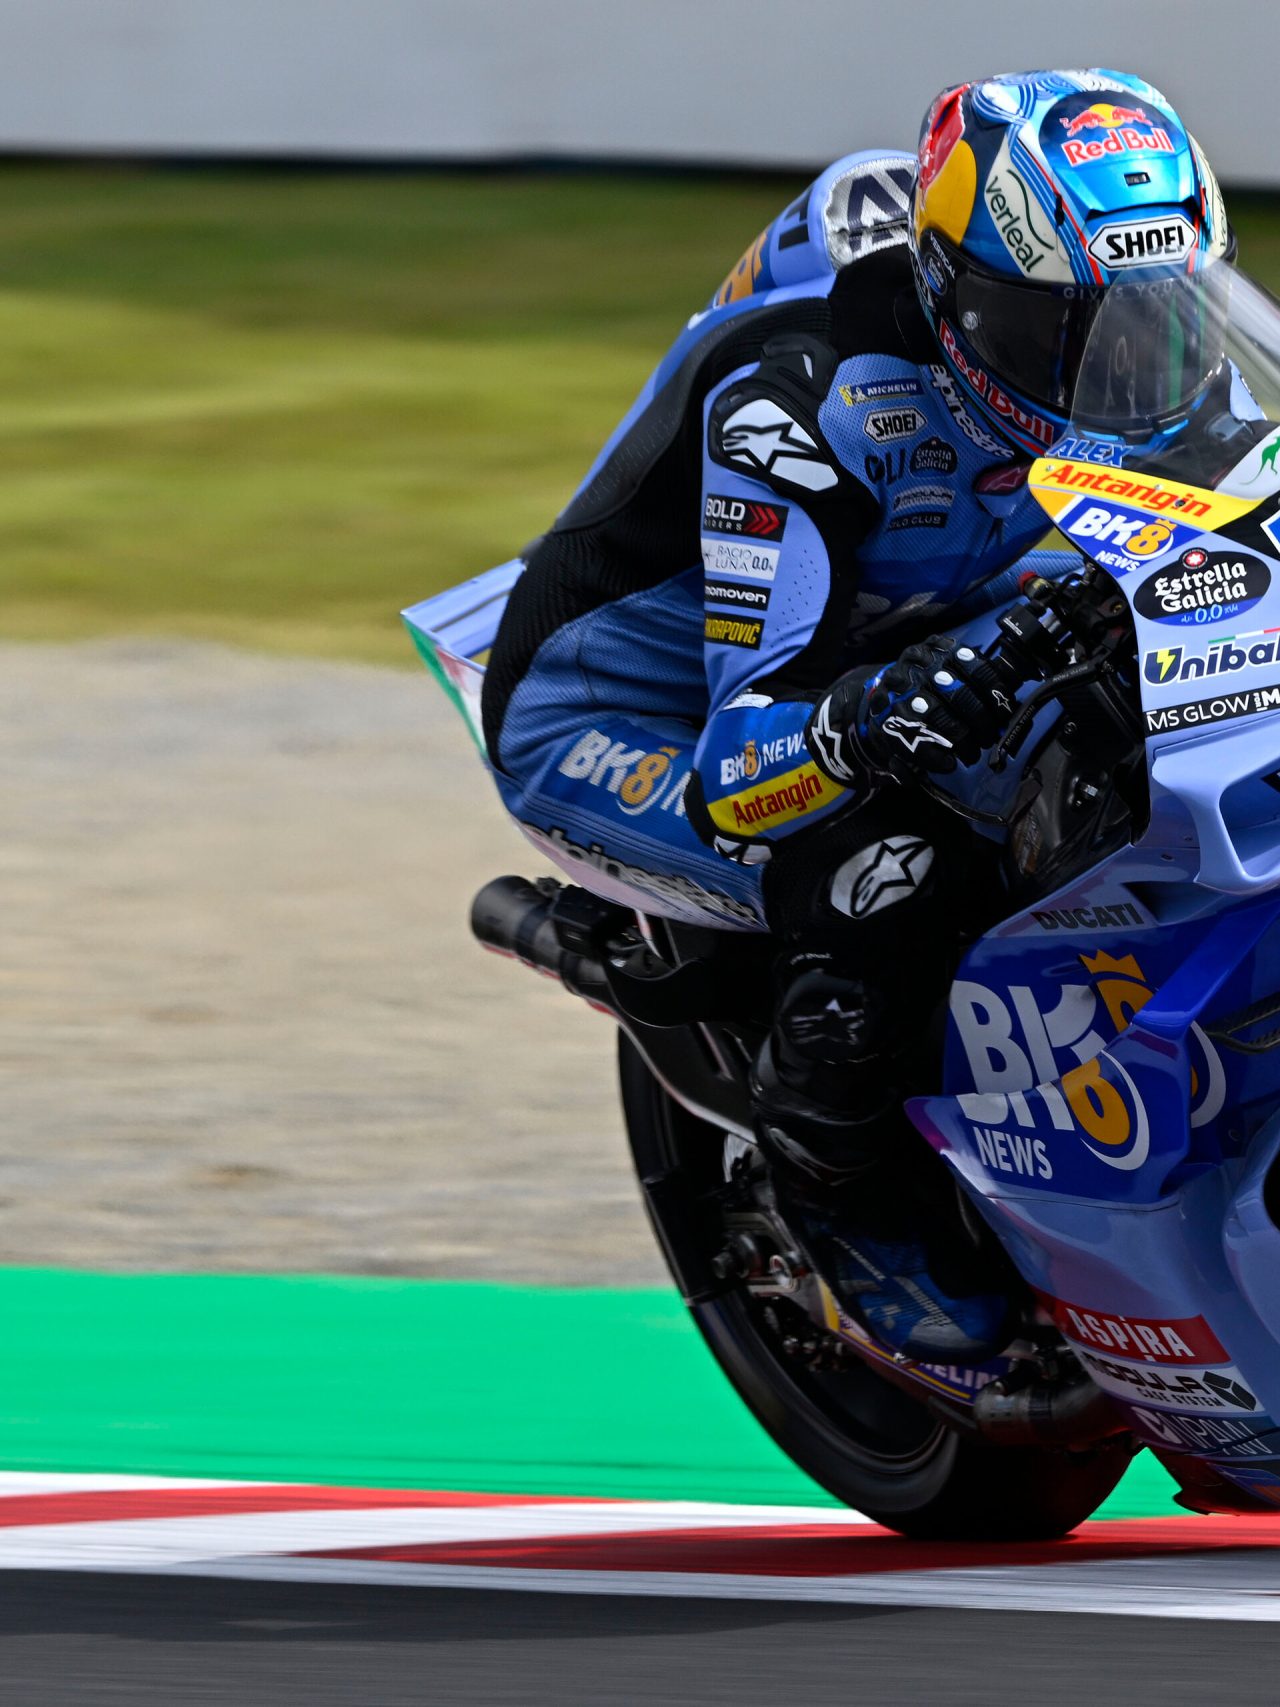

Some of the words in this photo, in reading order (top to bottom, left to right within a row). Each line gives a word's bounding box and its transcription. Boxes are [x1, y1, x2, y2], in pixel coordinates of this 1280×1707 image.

[1062, 129, 1125, 167] Red
[1124, 126, 1176, 154] Bull
[985, 176, 1044, 273] verleal
[1105, 225, 1185, 261] SHOEI
[867, 382, 917, 396] MICHELIN
[940, 318, 988, 397] Red
[987, 382, 1055, 448] Bull
[871, 413, 917, 438] SHOEI
[1049, 437, 1134, 468] ALEX
[705, 497, 746, 521] BOLD
[1042, 464, 1213, 519] Antangin
[1067, 505, 1168, 557] BK8
[1094, 550, 1142, 572] NEWS
[1154, 561, 1248, 597] Estrella
[1161, 581, 1248, 613] Galicia
[1146, 710, 1180, 732] MS
[1190, 694, 1252, 723] GLOW
[558, 728, 671, 807] BK8
[720, 743, 760, 786] BK8
[763, 733, 808, 767] NEW
[732, 772, 824, 829] Antangin
[1030, 903, 1144, 932] DUCATI
[973, 1127, 1053, 1180] NEWS
